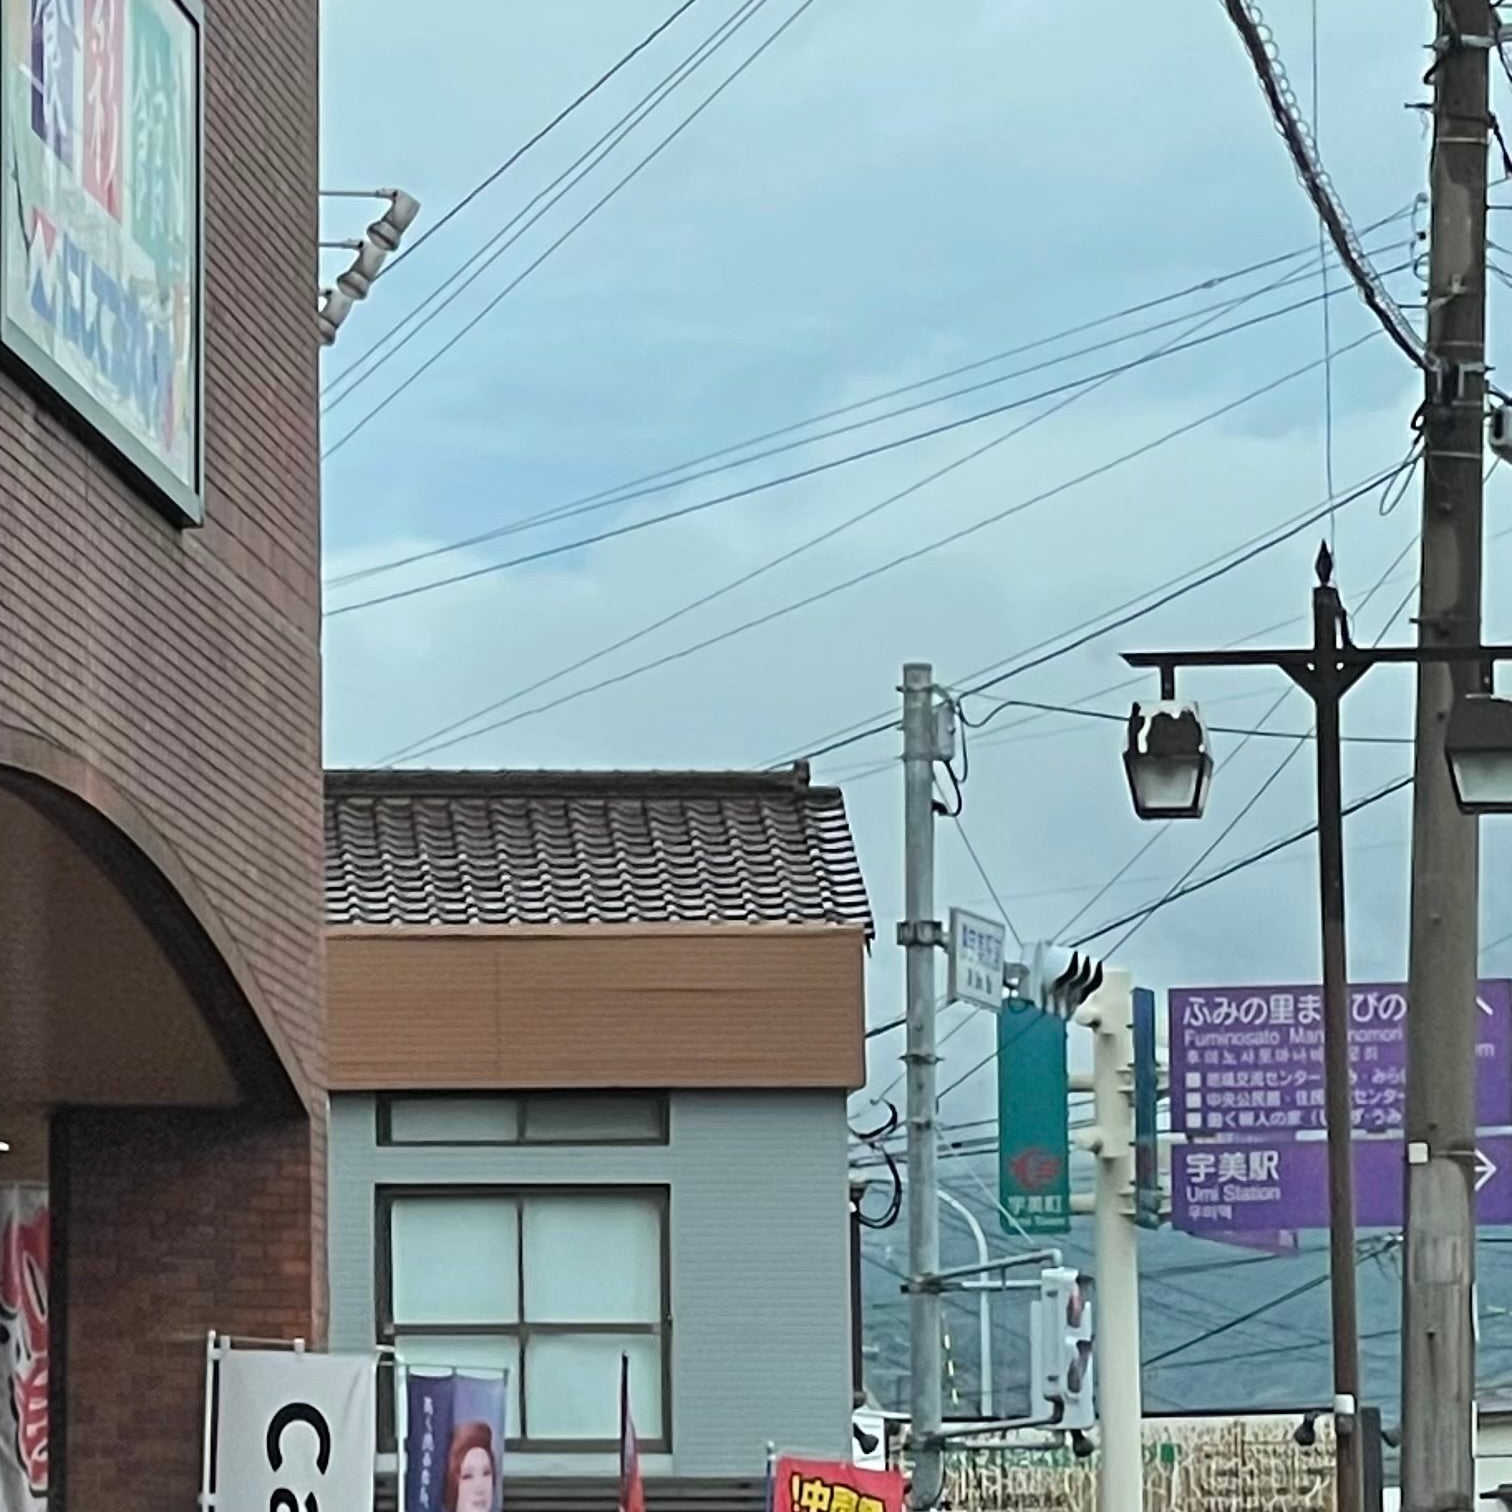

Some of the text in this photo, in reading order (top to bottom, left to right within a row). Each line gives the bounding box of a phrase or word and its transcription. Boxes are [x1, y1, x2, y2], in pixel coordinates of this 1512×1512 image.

[1183, 993, 1407, 1026] ふみの里まびの
[1184, 1028, 1403, 1047] Fuminosato Mannomori
[1186, 1150, 1280, 1183] 宇美駅
[1186, 1184, 1281, 1202] Umi Station
